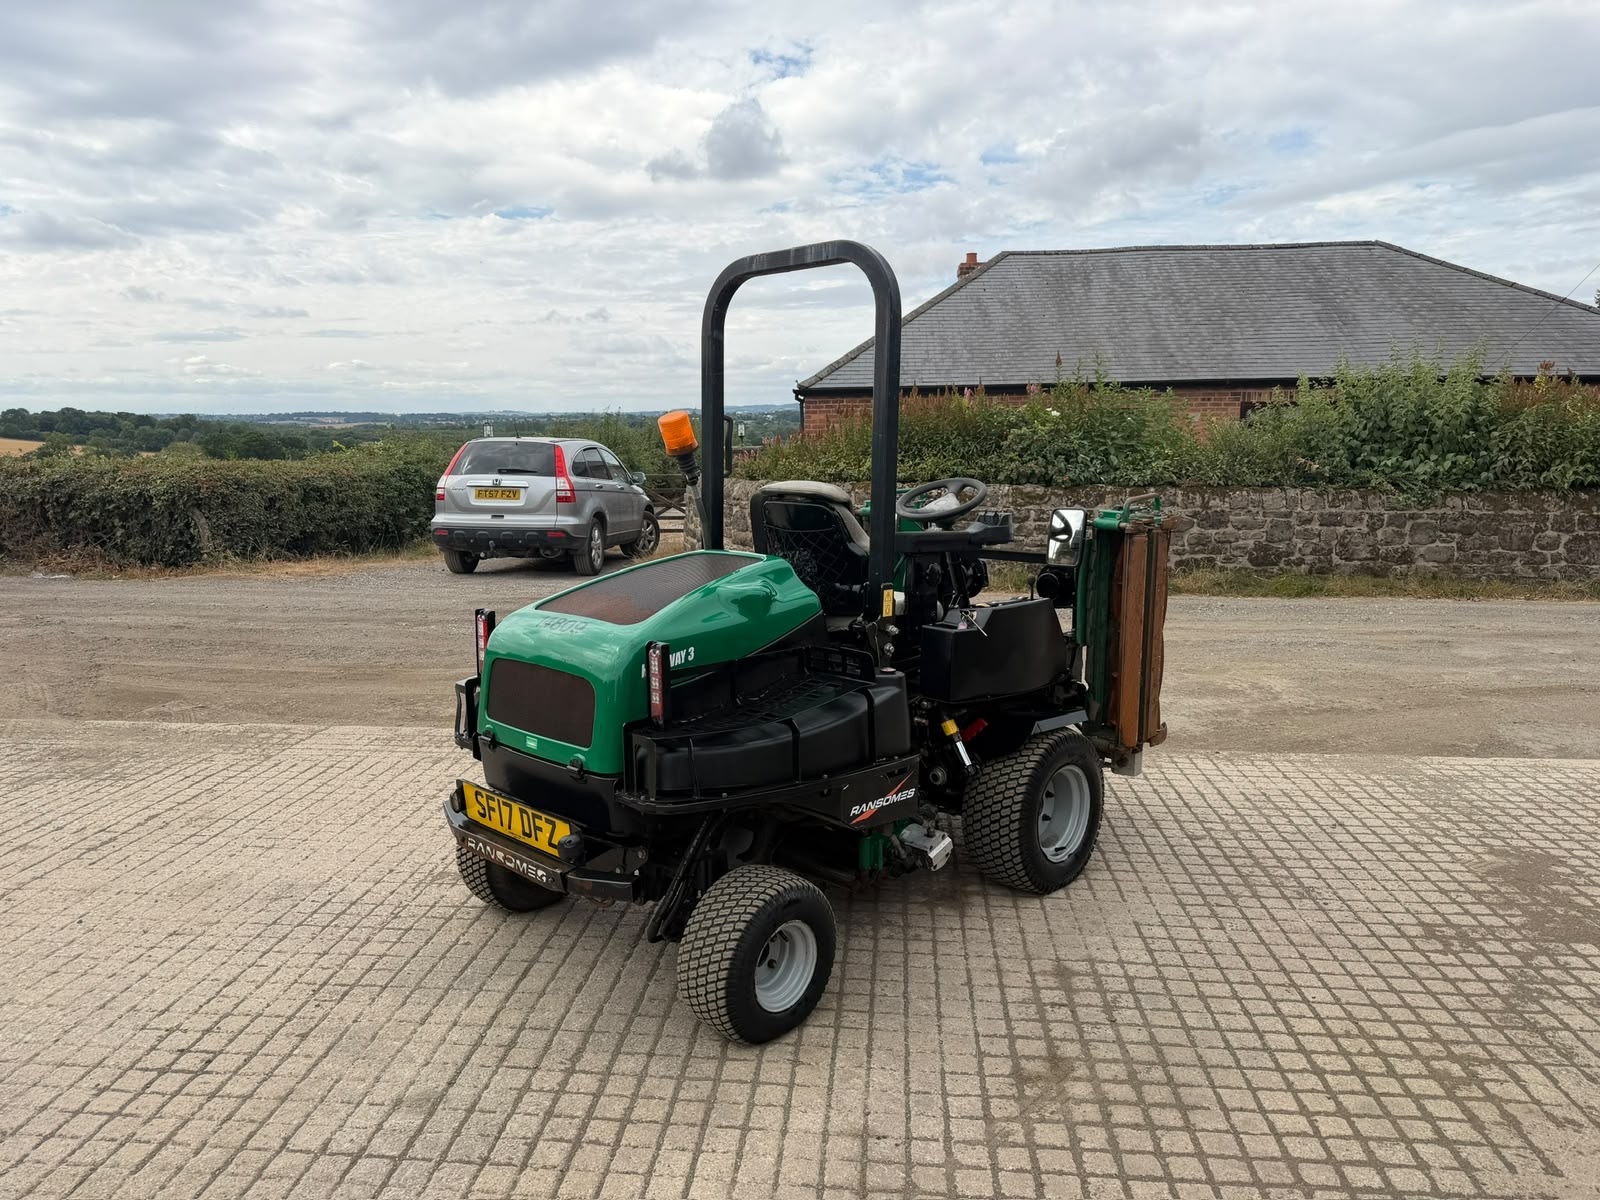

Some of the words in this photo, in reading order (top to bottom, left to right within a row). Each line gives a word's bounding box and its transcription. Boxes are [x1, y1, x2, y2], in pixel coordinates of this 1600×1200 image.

[687, 646, 695, 661] 3
[474, 790, 513, 830] SF17
[518, 807, 558, 849] DFZ
[849, 788, 916, 816] RANSOMES
[467, 838, 546, 882] RANSOMES
